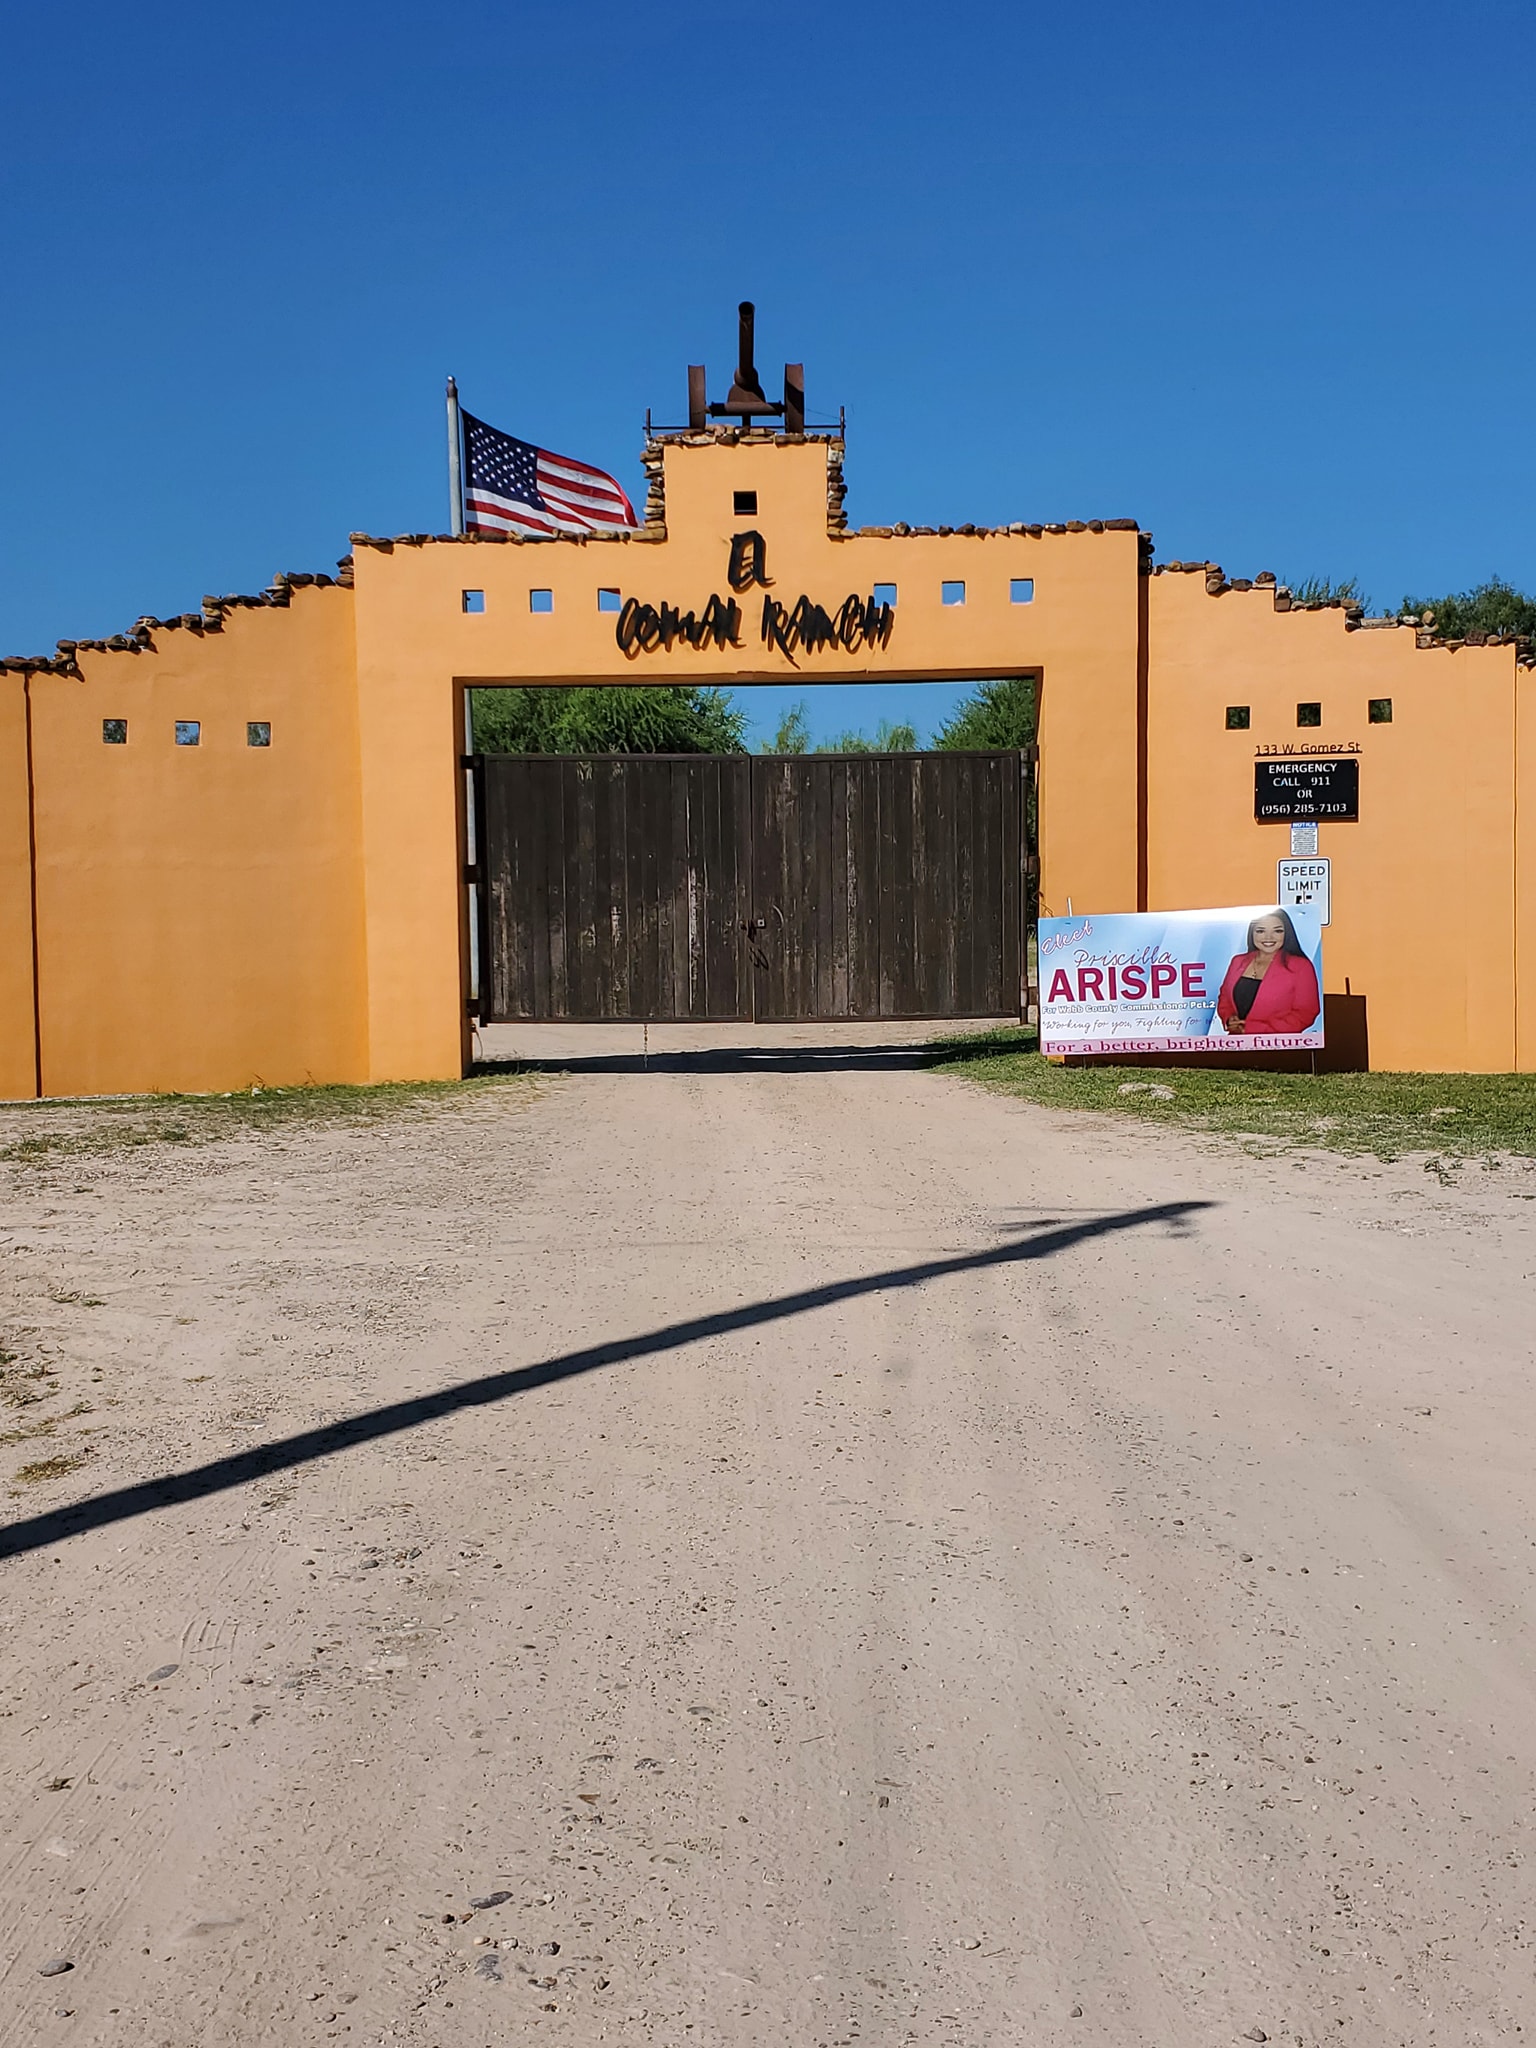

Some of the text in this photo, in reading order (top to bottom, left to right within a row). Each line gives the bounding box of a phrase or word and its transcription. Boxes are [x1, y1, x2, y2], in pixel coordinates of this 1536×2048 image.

[1255, 745, 1278, 756] 133
[1300, 743, 1344, 754] Gomez
[1347, 741, 1361, 753] St
[1268, 762, 1338, 774] EMERGENCY
[1272, 776, 1331, 787] CALL 911
[1296, 789, 1313, 799] OR
[1261, 803, 1347, 815] (956) 285-7103
[1282, 866, 1326, 877] SPEED
[1287, 880, 1322, 891] LIMIT
[1041, 919, 1094, 955] Elect
[1073, 945, 1178, 968] Priscilla
[1047, 962, 1207, 1003] ARISPE
[1041, 1006, 1057, 1015] For
[1058, 1005, 1084, 1014] Webb
[1085, 1004, 1118, 1014] County
[1120, 1002, 1187, 1012] Commissioner
[1092, 1019, 1110, 1033] for
[1184, 1015, 1201, 1030] for
[1045, 1042, 1076, 1053] For
[1082, 1043, 1093, 1052] a
[1099, 1039, 1159, 1052] better,
[1166, 1037, 1245, 1051] brighter
[1253, 1034, 1319, 1048] future.
